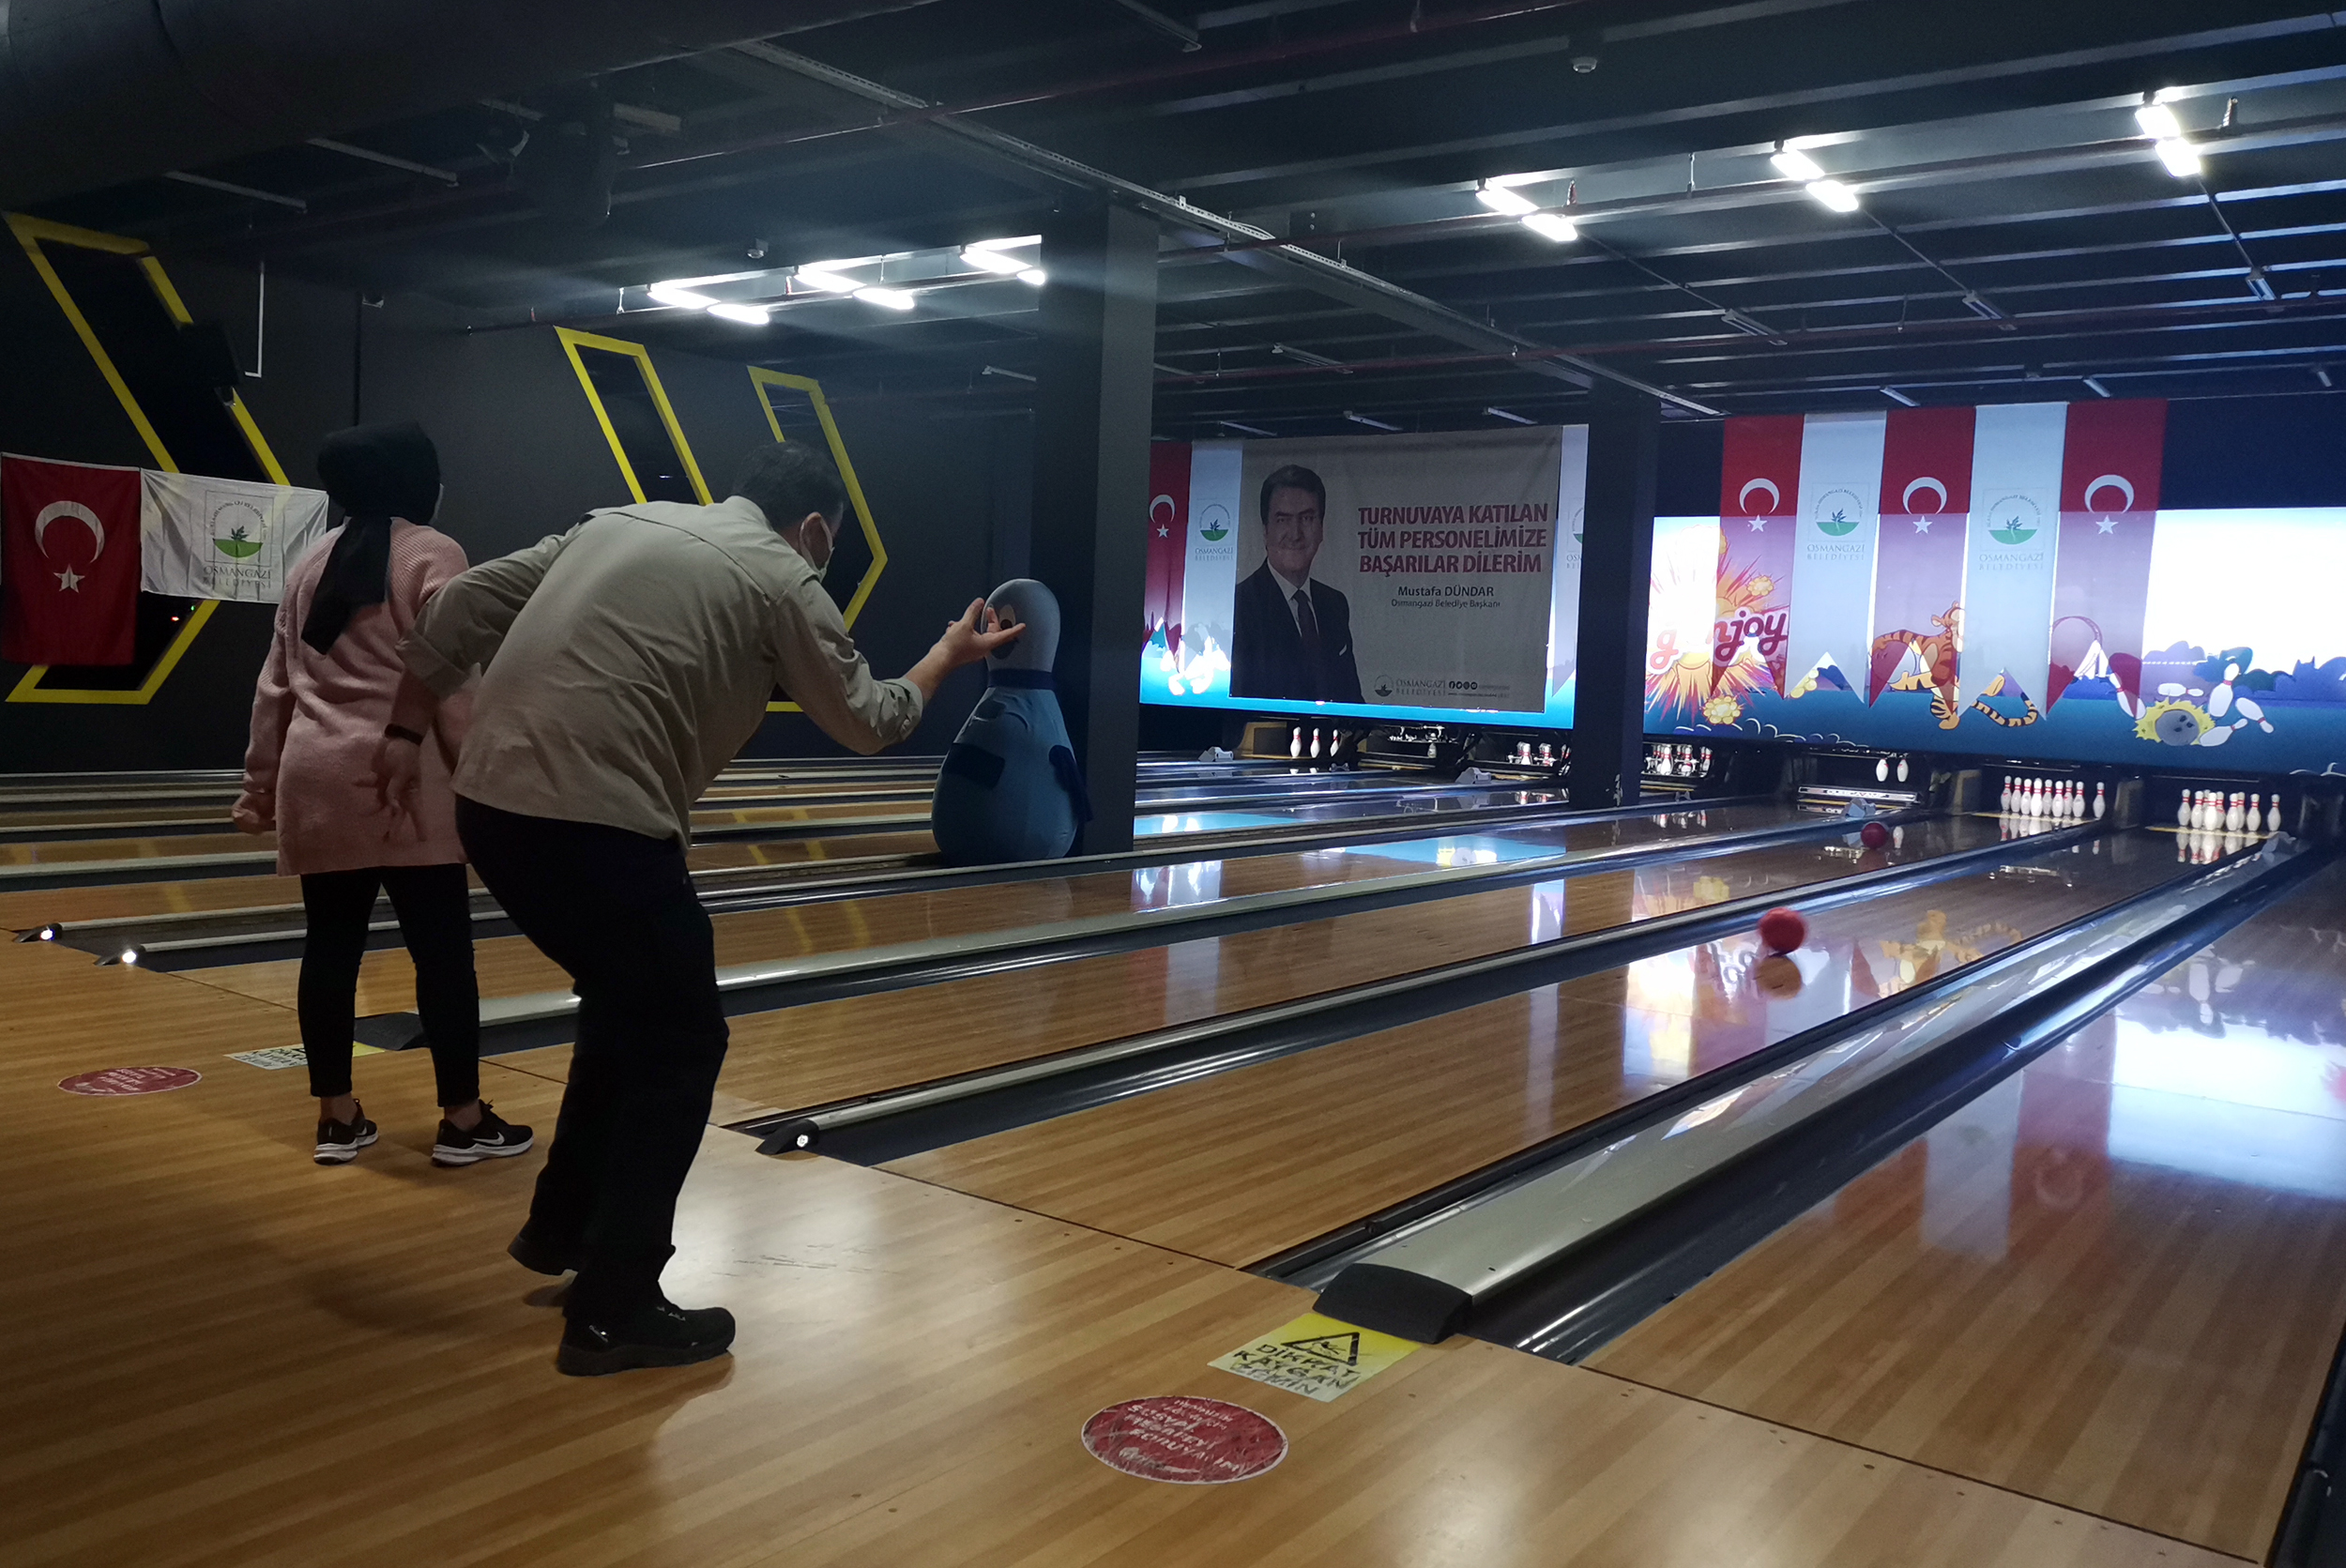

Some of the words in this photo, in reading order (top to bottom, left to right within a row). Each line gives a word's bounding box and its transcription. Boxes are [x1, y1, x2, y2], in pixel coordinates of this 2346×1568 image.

[1358, 505, 1465, 525] TURNUVAYA
[1469, 503, 1548, 524] KATILAN
[1358, 527, 1395, 549] TÜM
[1399, 525, 1547, 549] PERSONELİMİZE
[1359, 554, 1459, 577] BAŞARILAR
[1462, 550, 1542, 572] DİLERİM
[1397, 586, 1441, 597] Mustafa
[1444, 585, 1494, 597] DÜNDAR
[1391, 598, 1434, 609] Osmangazi
[1435, 599, 1469, 609] Belediye
[1470, 600, 1501, 610] Başkanı
[1256, 1343, 1362, 1378] DİKKAT
